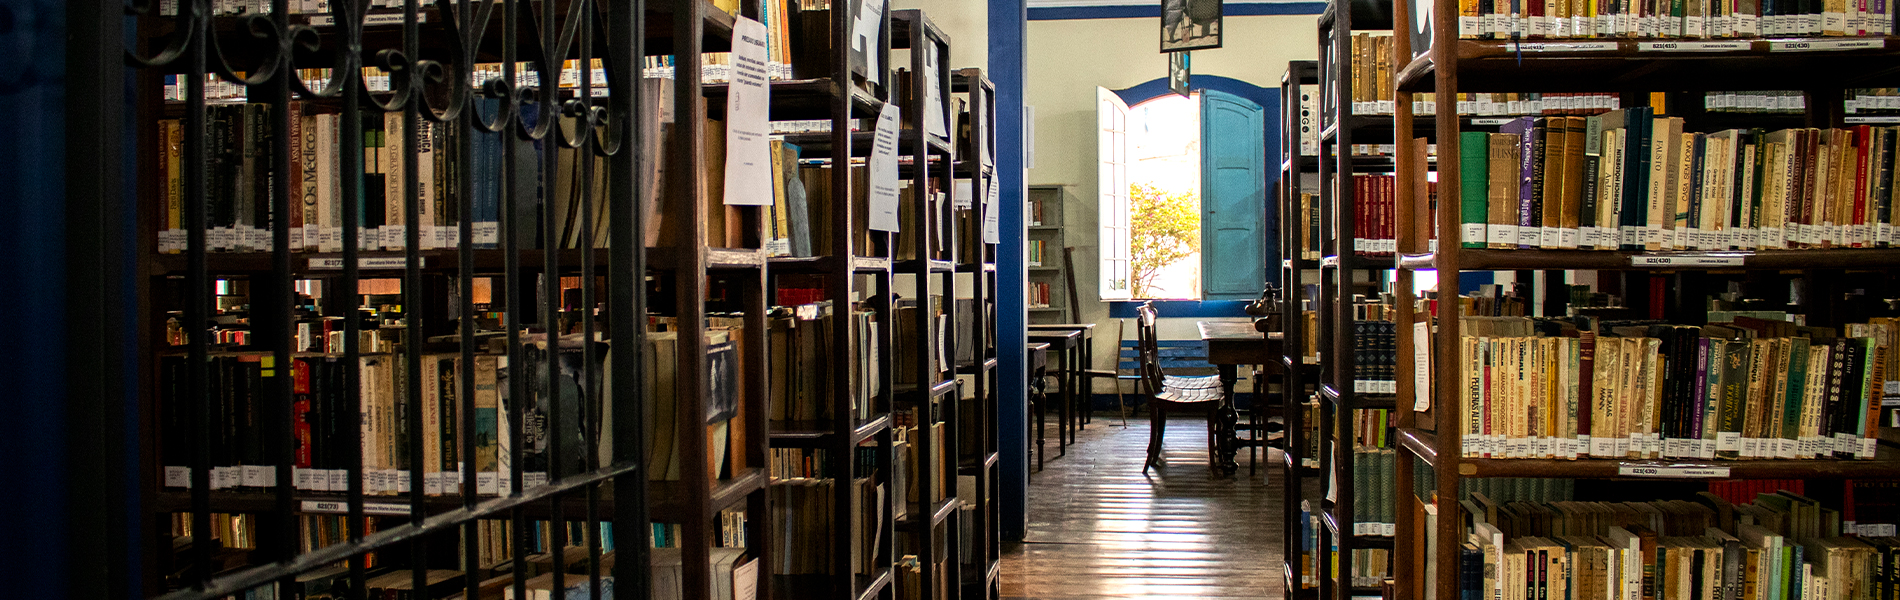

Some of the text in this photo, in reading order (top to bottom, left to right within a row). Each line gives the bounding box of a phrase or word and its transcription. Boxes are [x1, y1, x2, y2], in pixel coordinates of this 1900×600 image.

[291, 110, 300, 163] BARBARA DELINSKY
[1655, 140, 1663, 171] FAUSTO
[304, 186, 317, 205] Os
[1784, 218, 1788, 228] AS
[1787, 179, 1791, 190] DO
[1752, 344, 1760, 382] REMARQUE
[1471, 378, 1479, 410] PEQUENAS
[535, 414, 545, 440] finale
[1774, 410, 1780, 418] EM
